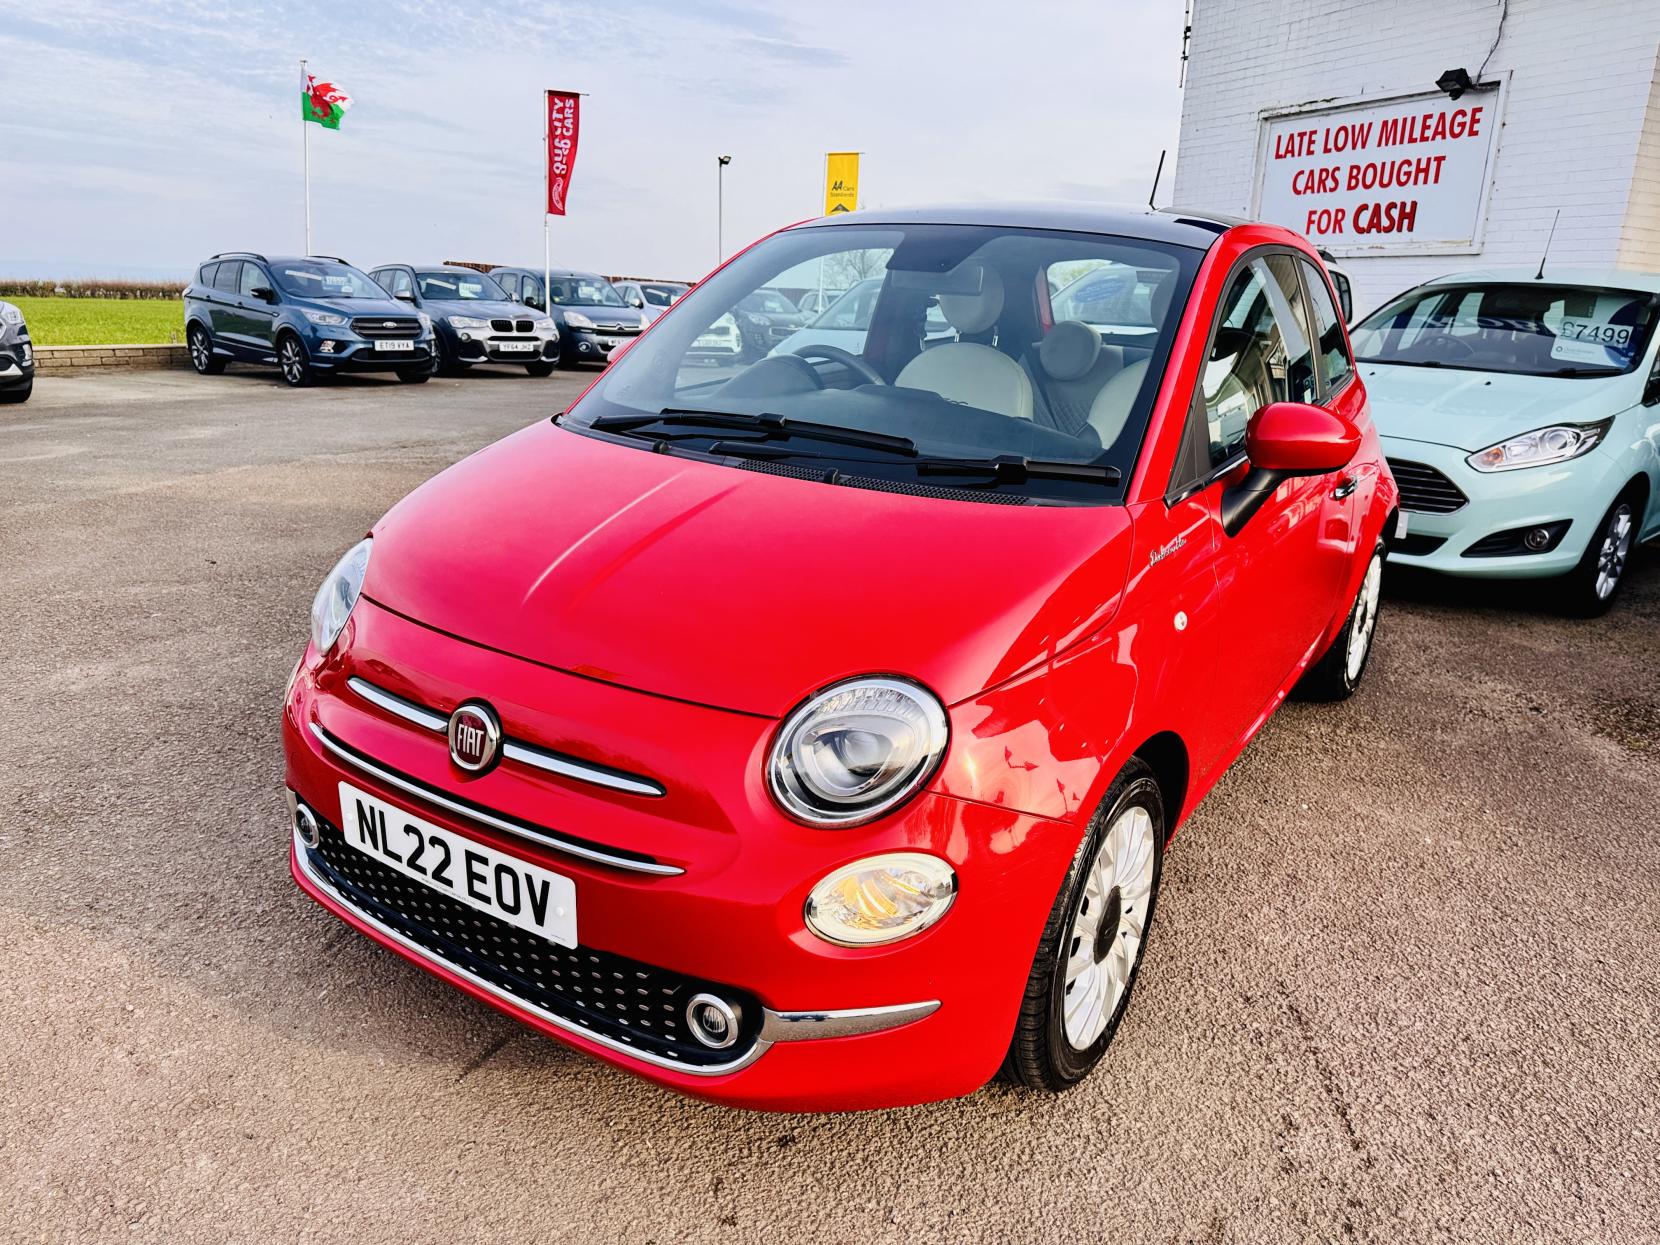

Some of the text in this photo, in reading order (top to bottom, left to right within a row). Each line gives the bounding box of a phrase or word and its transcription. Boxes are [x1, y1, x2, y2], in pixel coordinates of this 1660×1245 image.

[563, 98, 575, 136] CARS
[1274, 106, 1484, 160] LATE LOW MILEAGE
[1292, 155, 1446, 196] CARS BOUGHT
[1305, 200, 1418, 235] FOR CASH
[1560, 321, 1630, 345] £7499
[457, 723, 485, 757] FIAT
[355, 798, 551, 928] NL22 EOV
